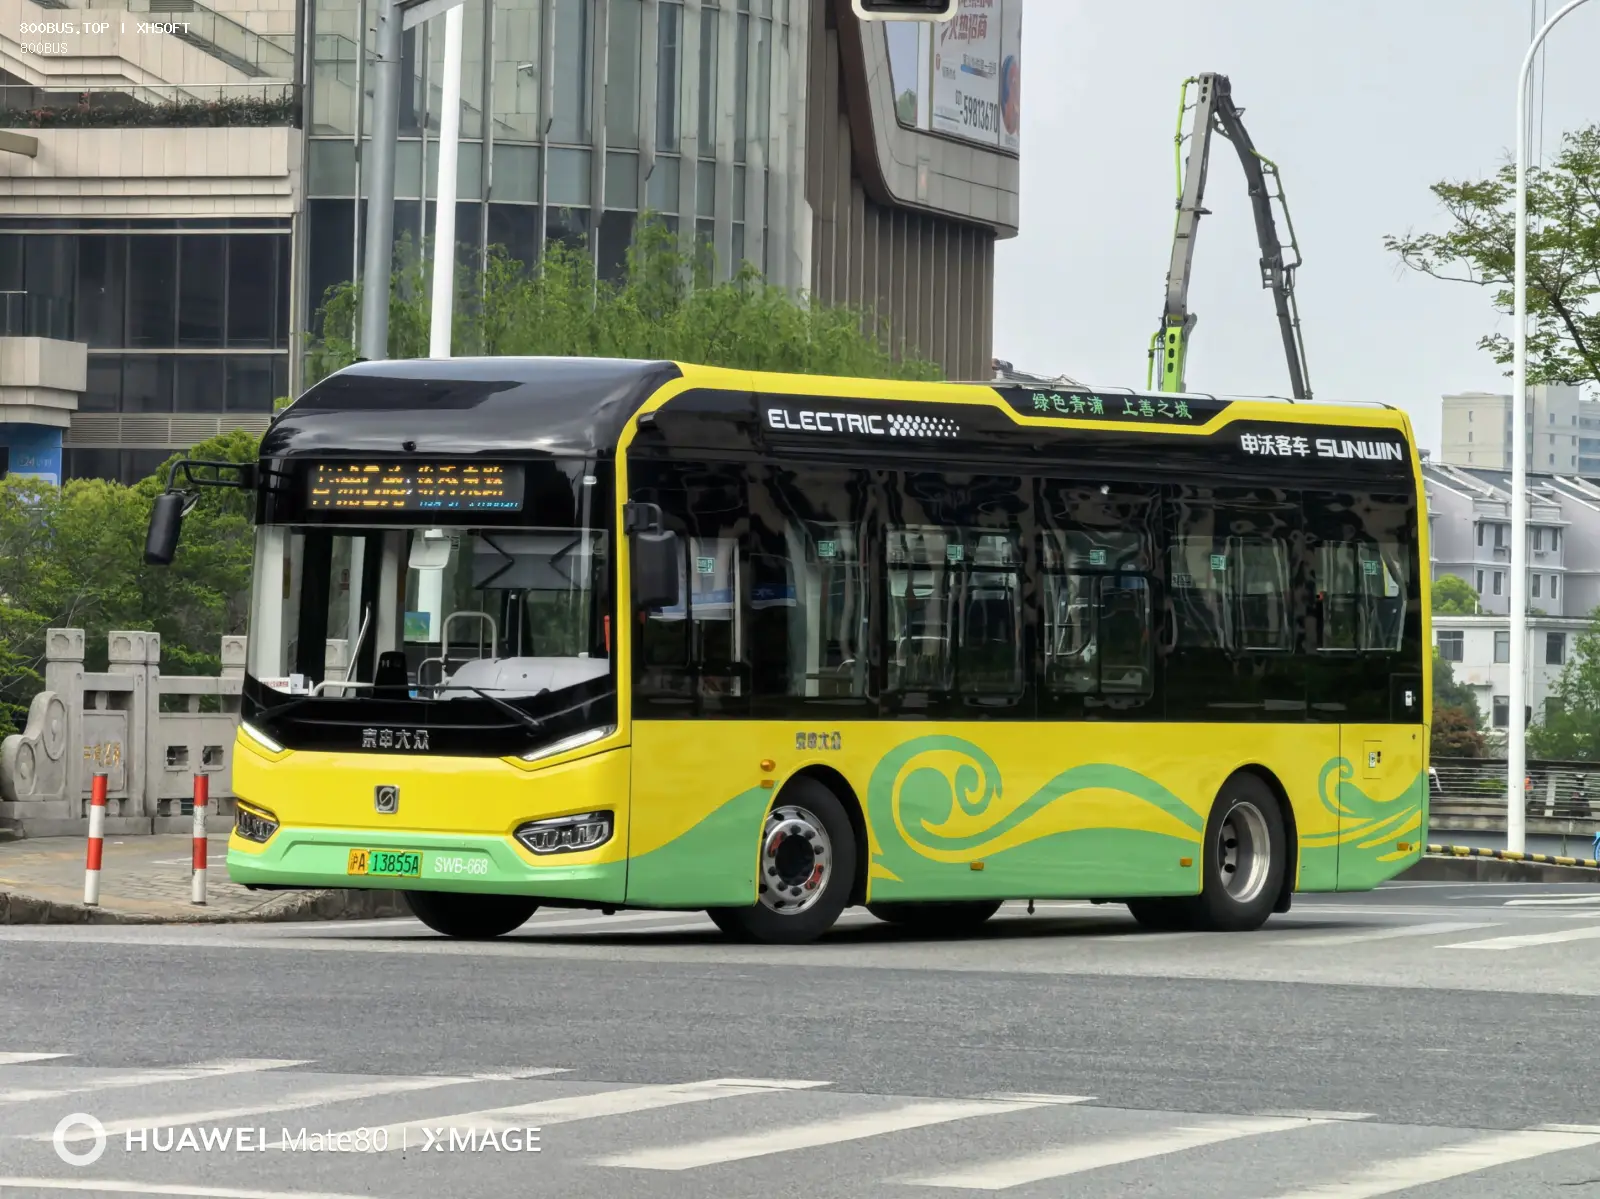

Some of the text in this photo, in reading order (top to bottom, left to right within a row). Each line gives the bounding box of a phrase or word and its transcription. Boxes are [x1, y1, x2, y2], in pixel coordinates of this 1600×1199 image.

[1032, 393, 1193, 420] 绿色青浦 上善之城
[768, 409, 885, 435] ELECTRIC
[1240, 433, 1403, 461] 申沃客车 SUNWIN
[349, 852, 420, 875] 沪A 13855A
[434, 856, 489, 875] SWB-668
